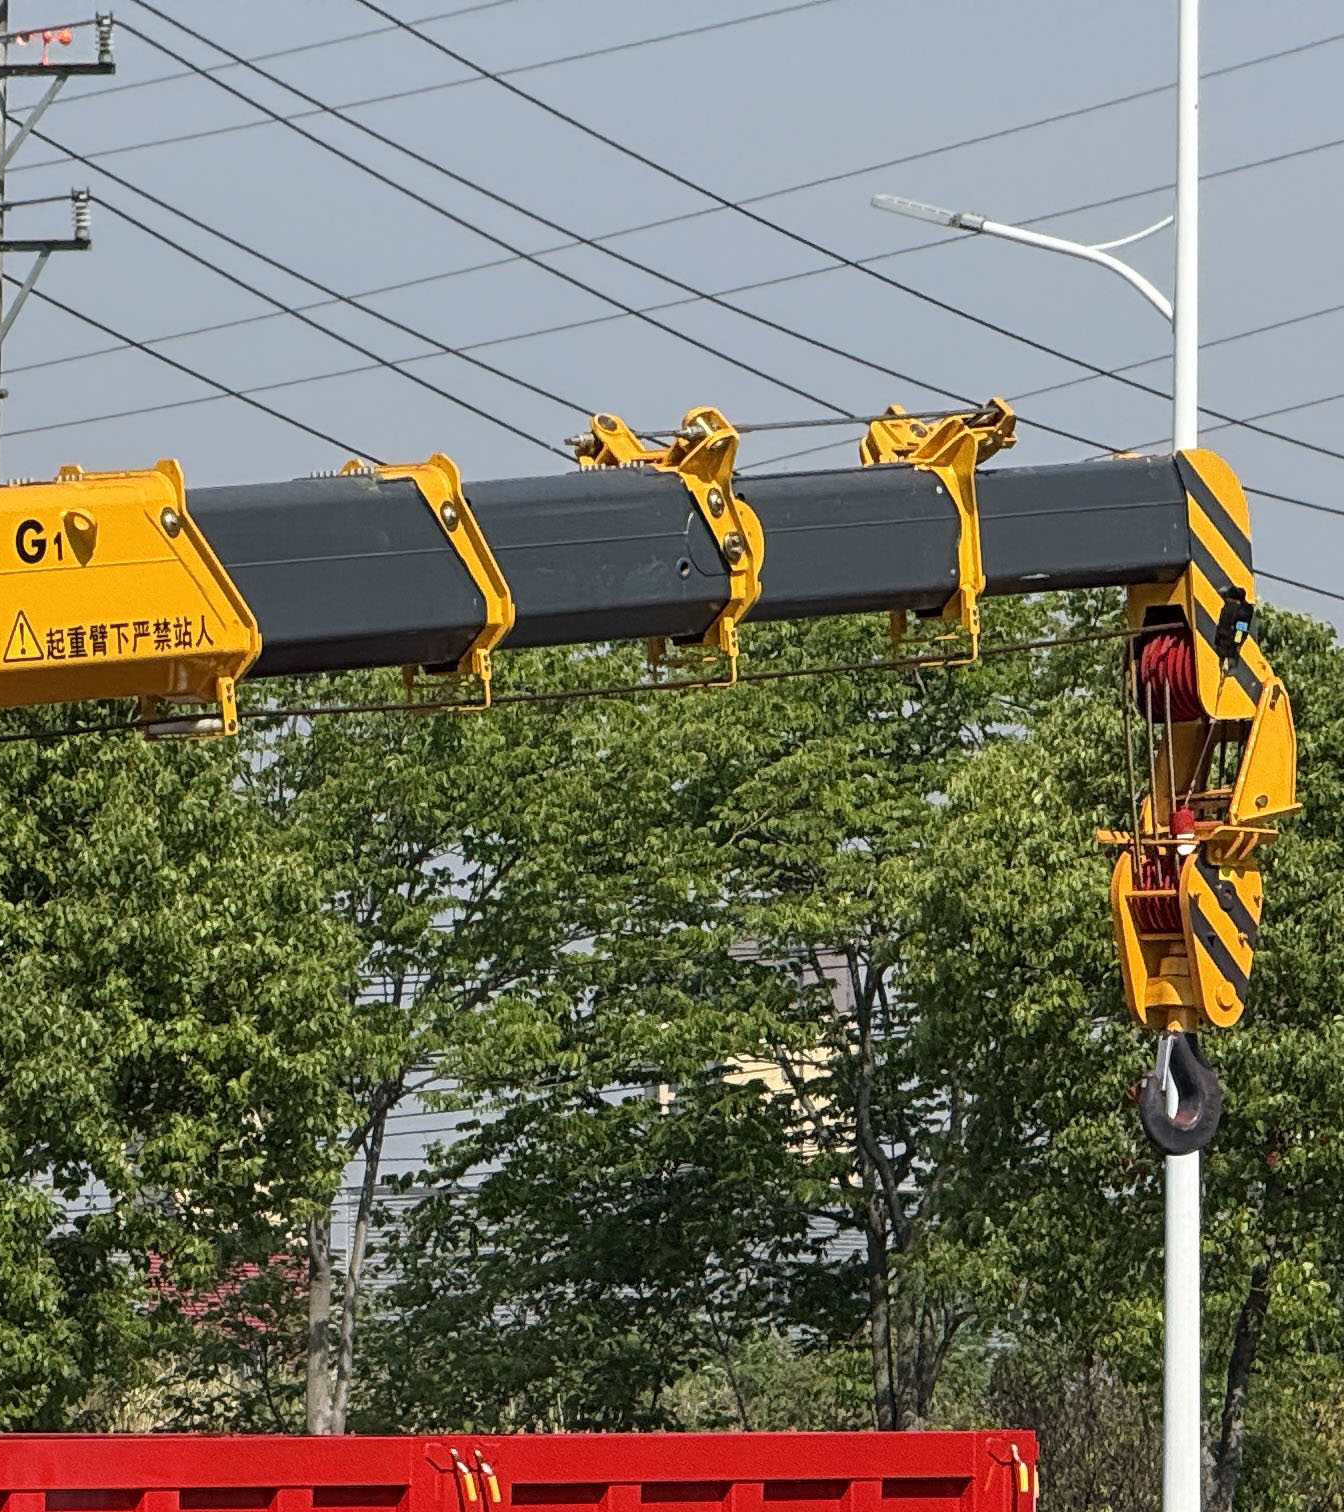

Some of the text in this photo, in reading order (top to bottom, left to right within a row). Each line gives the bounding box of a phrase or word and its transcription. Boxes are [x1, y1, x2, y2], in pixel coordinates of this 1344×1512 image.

[15, 518, 64, 564] G1
[45, 613, 214, 660] 起重臂下严禁站人
